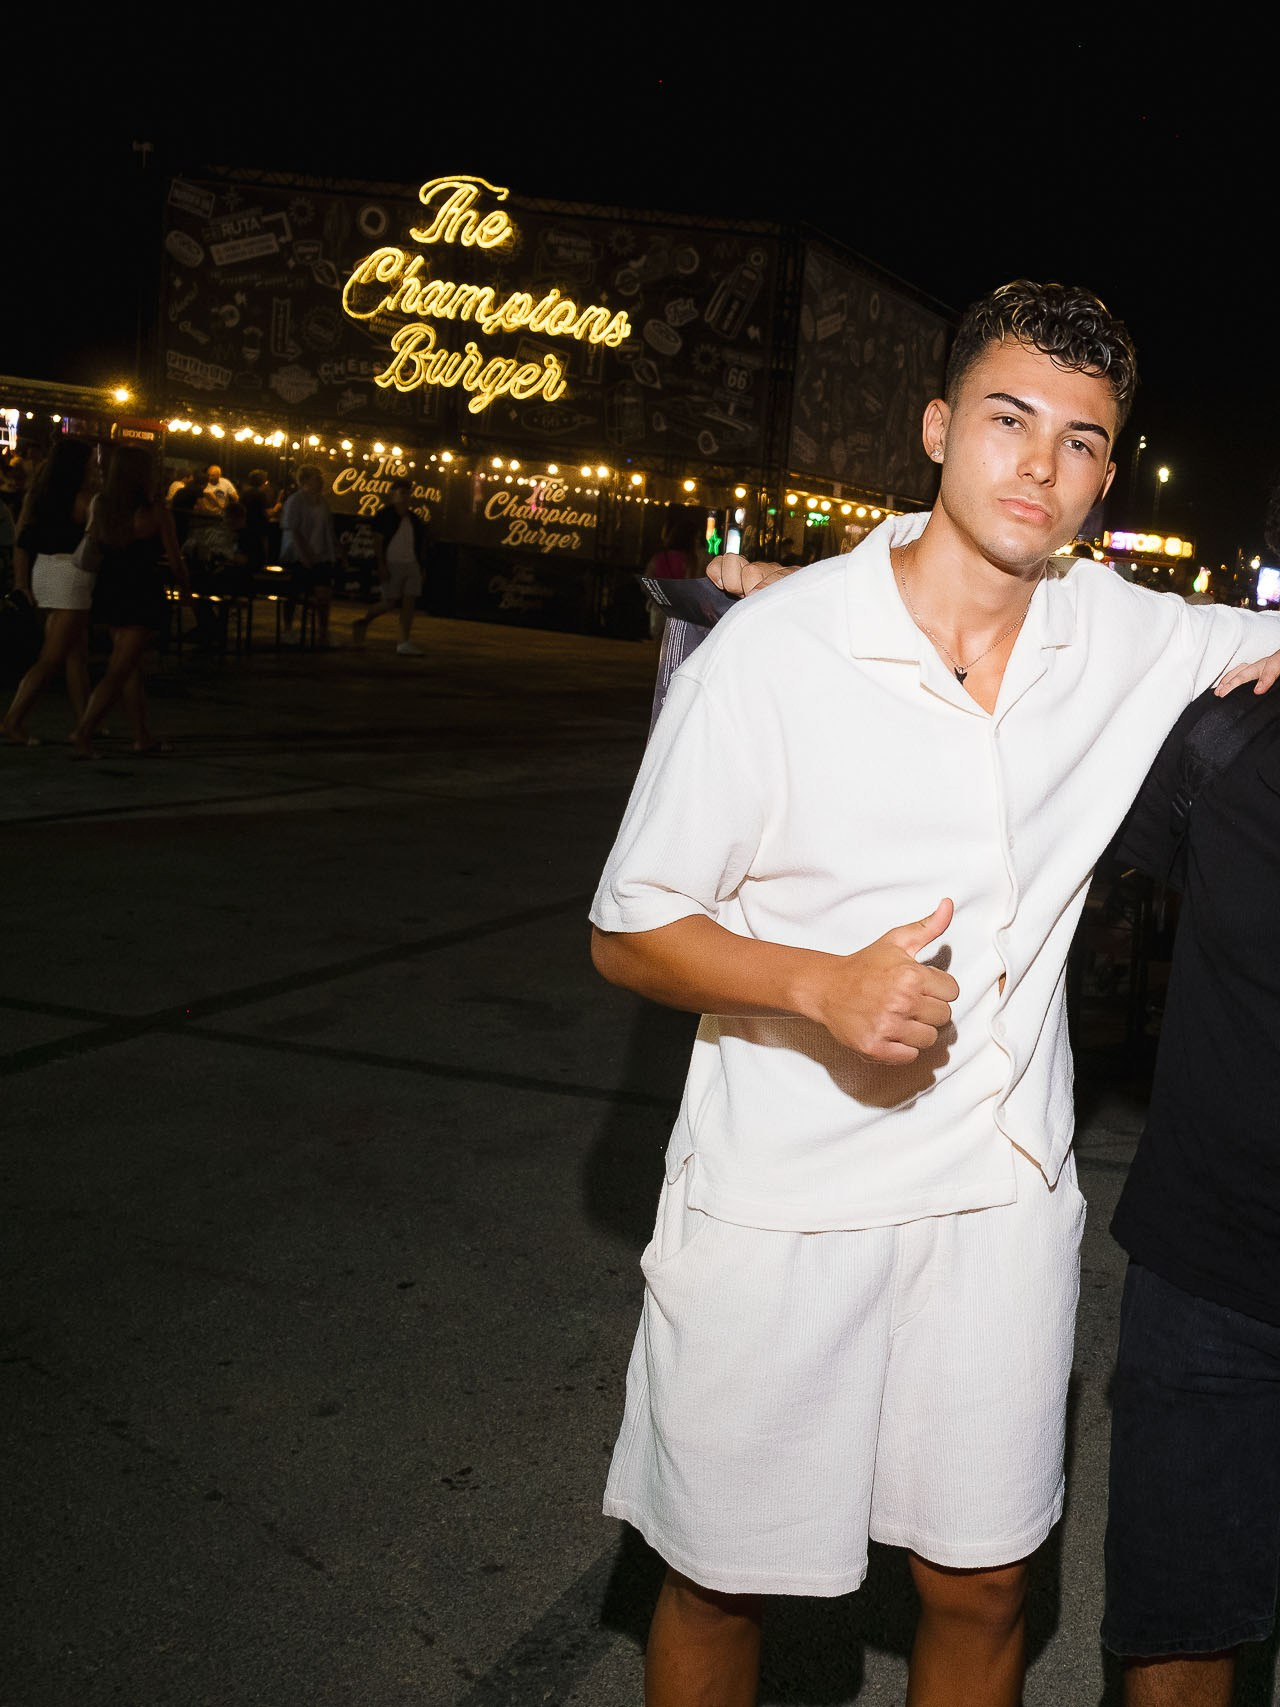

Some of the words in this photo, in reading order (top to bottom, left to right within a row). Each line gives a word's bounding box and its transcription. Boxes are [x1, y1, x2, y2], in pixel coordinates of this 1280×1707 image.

[409, 175, 513, 248] The
[343, 247, 631, 347] Champions
[374, 323, 567, 414] Burger
[370, 453, 408, 478] The
[332, 467, 441, 502] Chamons
[525, 474, 566, 503] The
[501, 519, 581, 554] Burger
